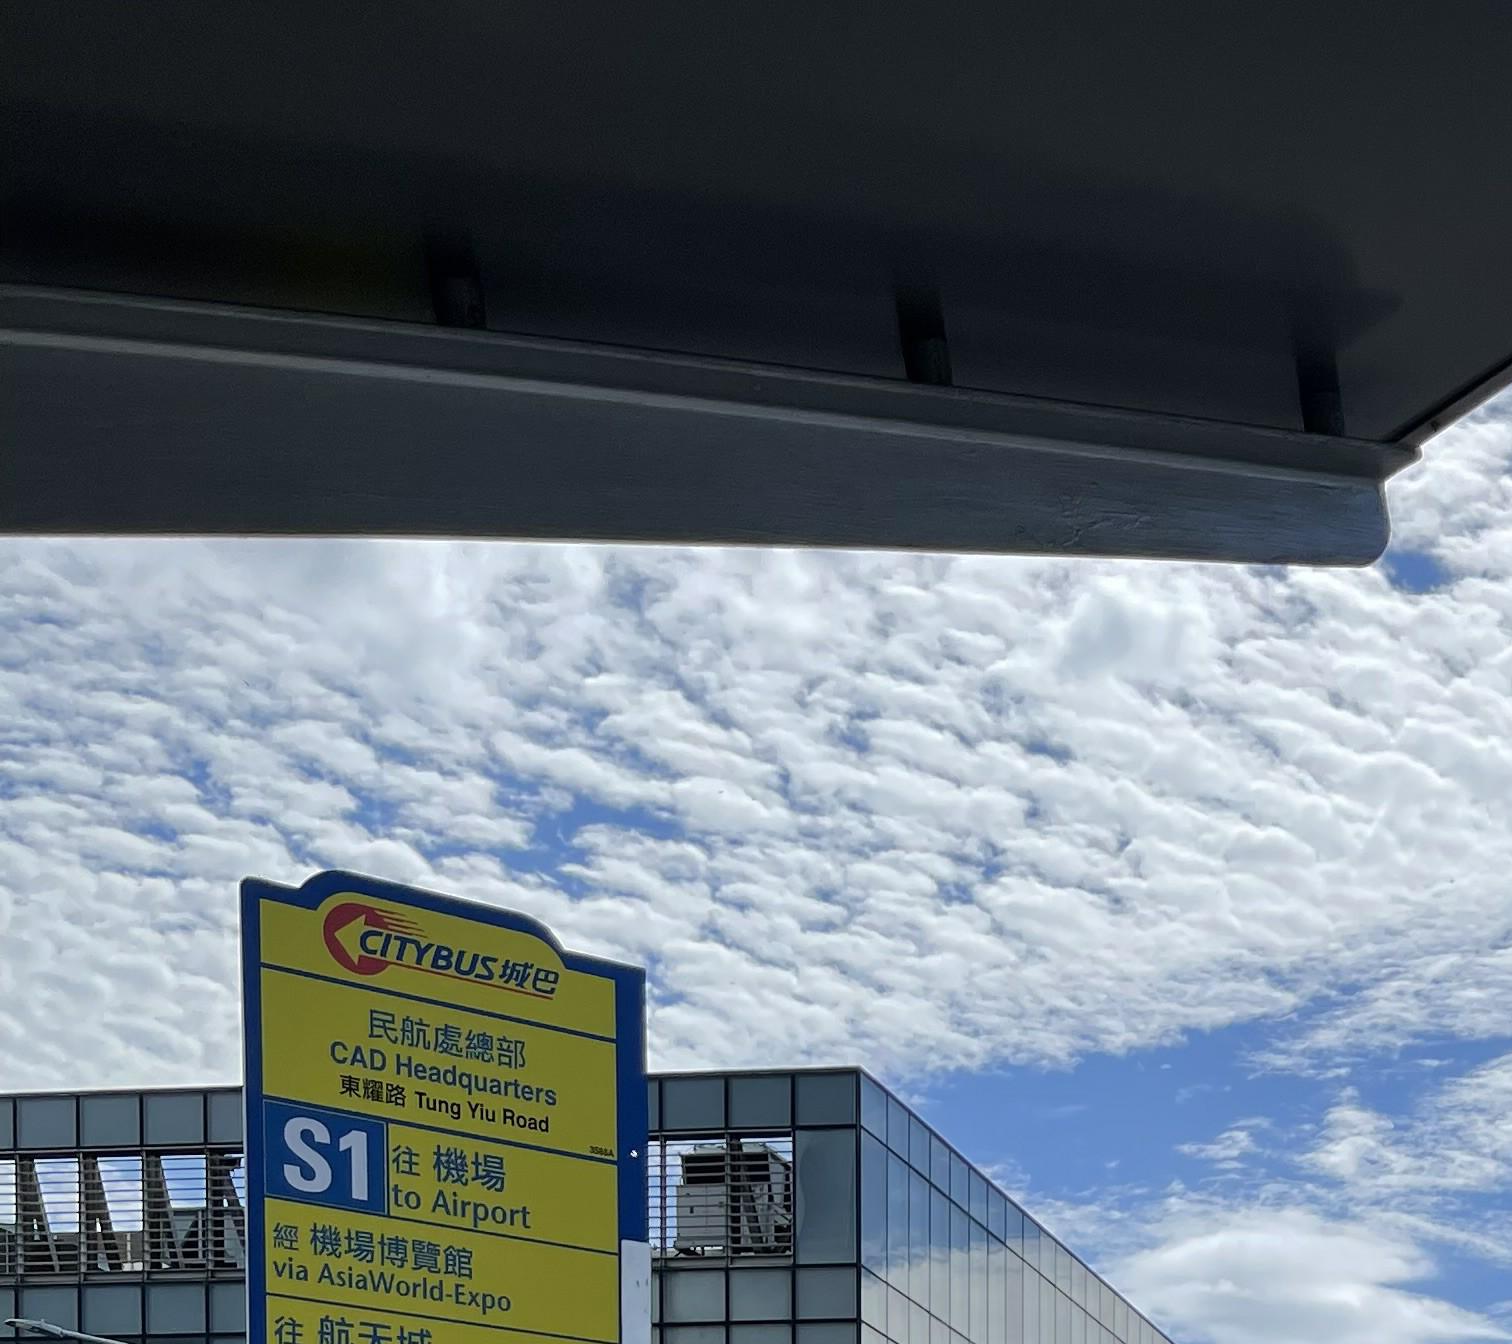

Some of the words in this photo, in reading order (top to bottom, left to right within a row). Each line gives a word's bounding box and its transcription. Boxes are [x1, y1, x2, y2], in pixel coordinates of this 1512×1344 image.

[359, 929, 499, 981] CITYBUS
[500, 959, 560, 995] 城巴
[368, 1009, 526, 1069] 民航處總部
[330, 1041, 387, 1071] CAD
[396, 1054, 557, 1106] Headquarters
[339, 1074, 406, 1108] 東耀路
[415, 1091, 461, 1120] Tung
[467, 1101, 496, 1123] Yiu
[503, 1108, 549, 1133] Road
[283, 1117, 368, 1200] S1
[392, 1145, 421, 1177] 往
[433, 1145, 506, 1192] 機場
[392, 1184, 421, 1210] to
[432, 1190, 531, 1228] Airport
[272, 1222, 299, 1251] 經
[310, 1222, 473, 1280] 機場博覽館
[272, 1257, 309, 1282] via
[318, 1263, 511, 1315] AsiaWorld-Expo
